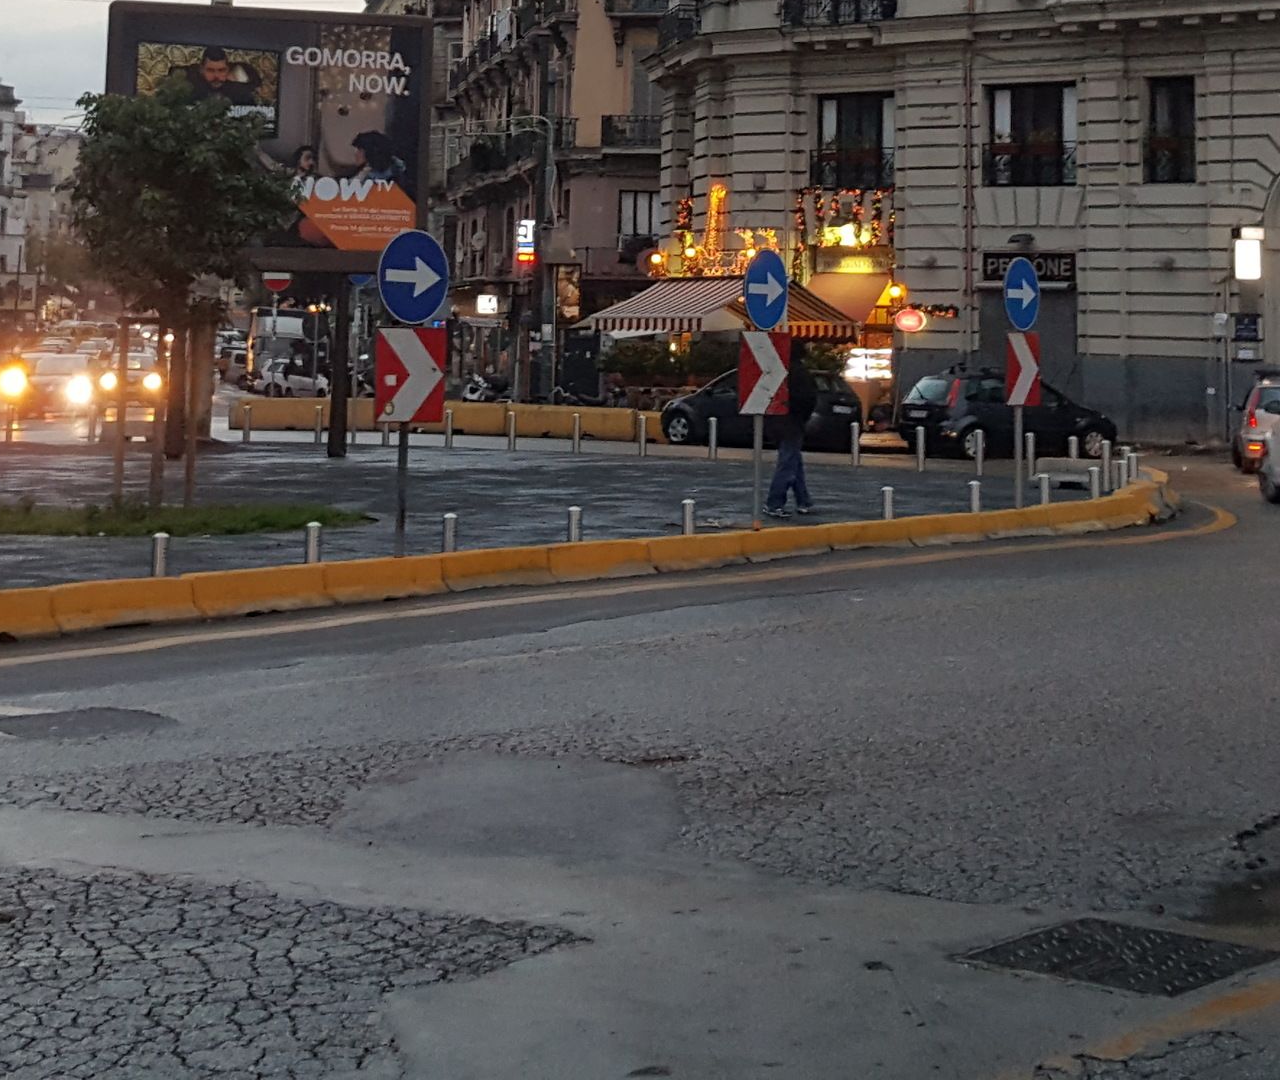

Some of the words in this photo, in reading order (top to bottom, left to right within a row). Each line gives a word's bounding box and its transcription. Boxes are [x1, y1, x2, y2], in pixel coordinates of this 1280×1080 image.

[286, 46, 411, 75] GOMORRA,
[349, 73, 411, 96] NOW.
[290, 176, 373, 201] NOW
[375, 180, 394, 192] TV
[986, 258, 1072, 276] PEONE
